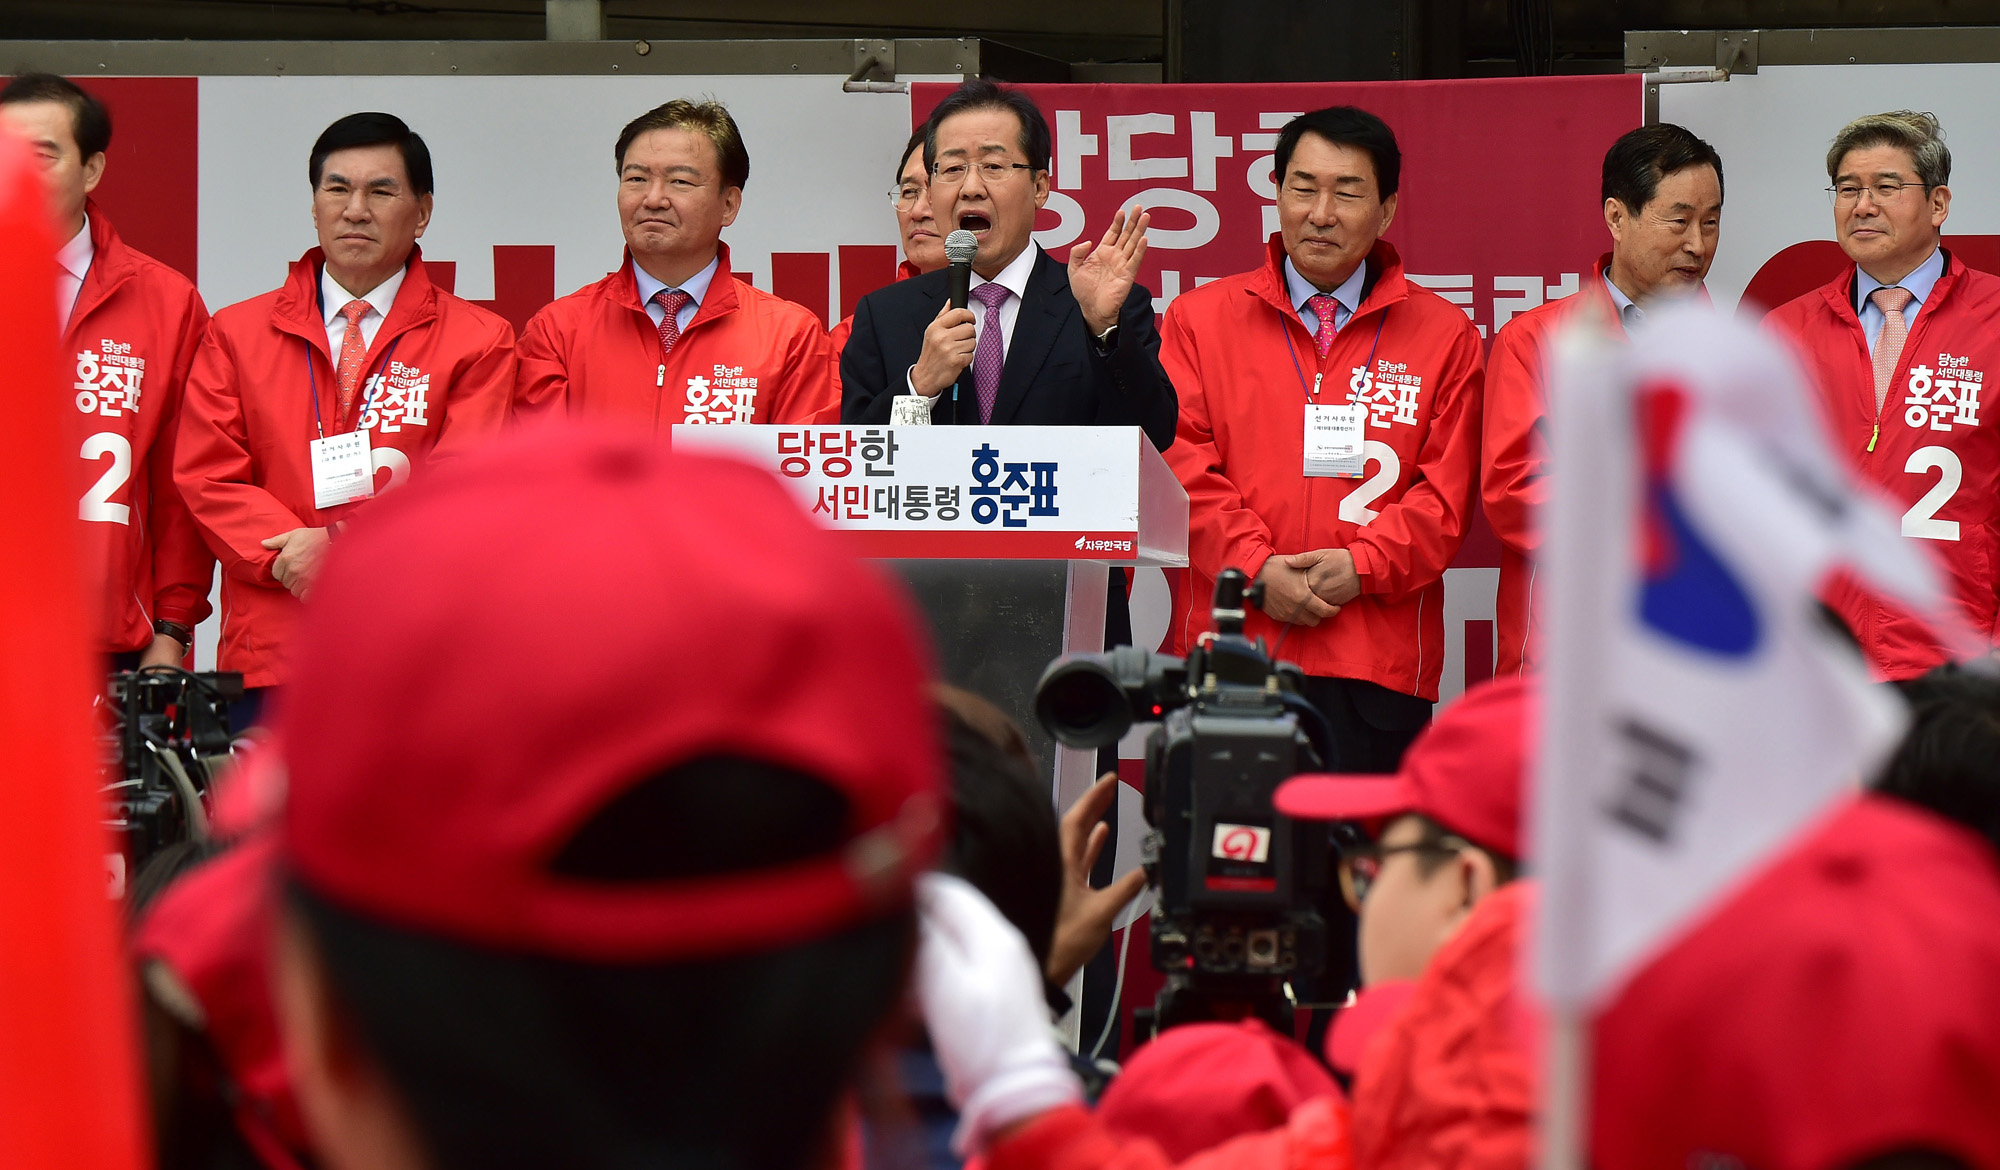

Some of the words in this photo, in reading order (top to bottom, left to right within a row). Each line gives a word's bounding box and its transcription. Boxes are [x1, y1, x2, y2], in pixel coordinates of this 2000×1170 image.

[101, 339, 131, 354] 당당한
[101, 354, 145, 369] 서민대통령
[1378, 359, 1407, 373] 당당한
[1938, 353, 1969, 367] 당당한
[390, 361, 419, 378] 당당한
[713, 364, 743, 378] 당당한
[1936, 367, 1983, 382] 서민대통령
[74, 350, 144, 417] 홍준표
[712, 378, 758, 388] 서민대통령
[1376, 373, 1422, 386] 서민대통령
[359, 373, 429, 433] 홍준표
[1345, 365, 1421, 429] 홍준표
[1904, 364, 1982, 432] 홍준표
[777, 429, 899, 478] 당당한
[79, 432, 131, 526] 2
[811, 485, 960, 521] 서민대통령
[969, 443, 1060, 527] 홍준표
[1338, 440, 1400, 527] 2
[1901, 446, 1962, 541] 2
[1085, 539, 1132, 551] 자유한국당
